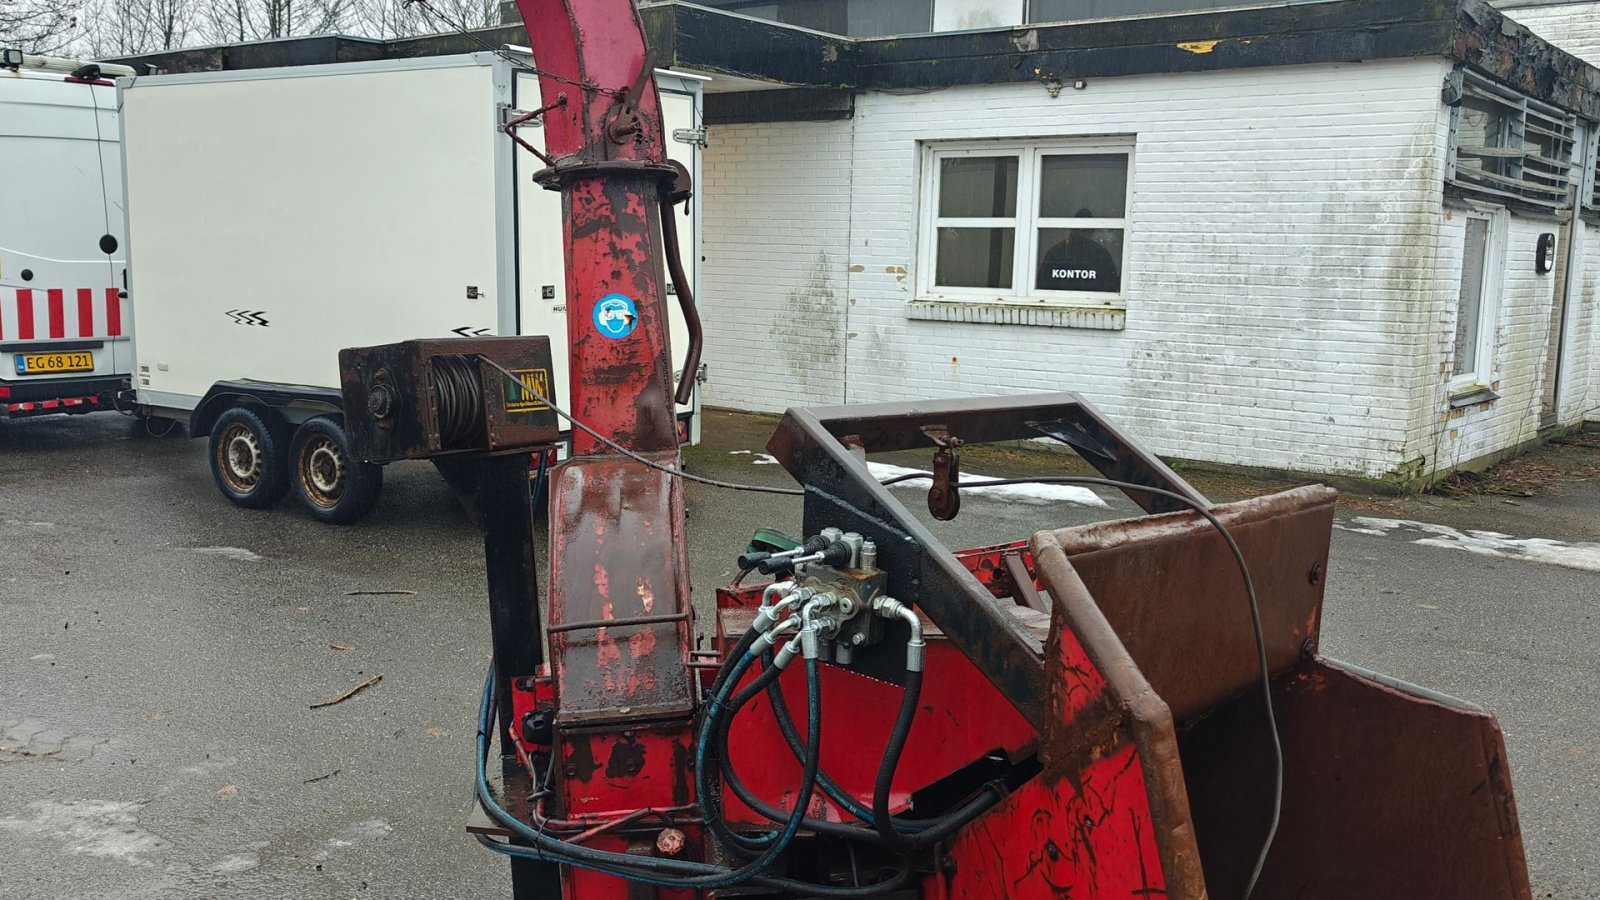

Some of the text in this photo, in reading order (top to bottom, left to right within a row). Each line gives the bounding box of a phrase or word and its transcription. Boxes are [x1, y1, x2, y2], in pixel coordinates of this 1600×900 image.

[1051, 269, 1097, 279] KONTOR
[26, 355, 90, 369] EG 68 121
